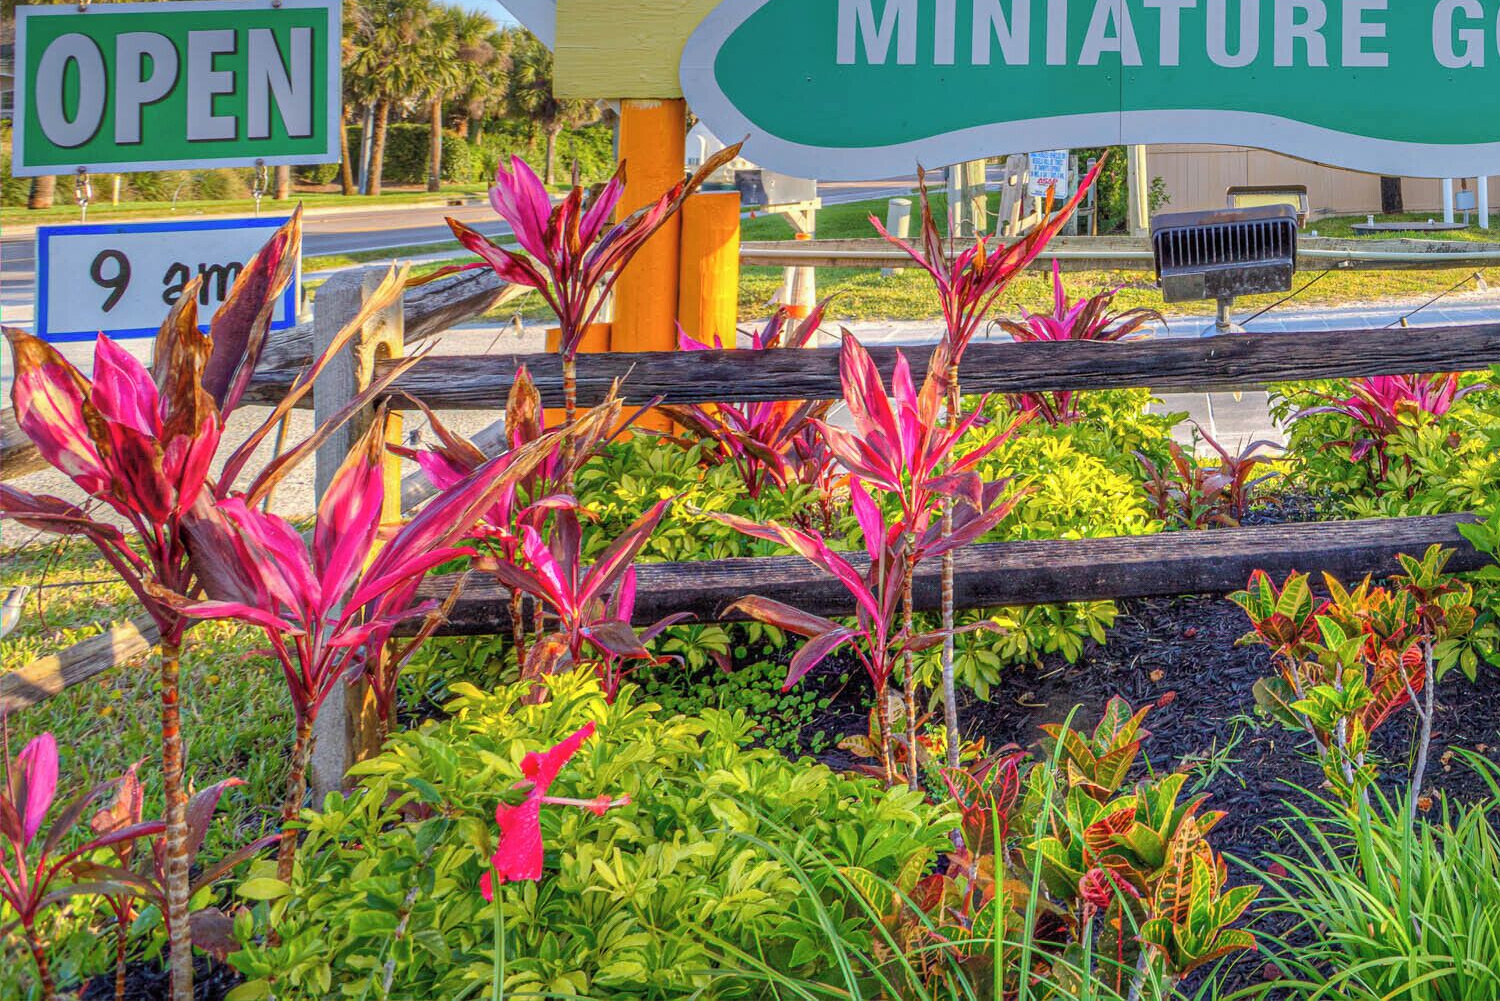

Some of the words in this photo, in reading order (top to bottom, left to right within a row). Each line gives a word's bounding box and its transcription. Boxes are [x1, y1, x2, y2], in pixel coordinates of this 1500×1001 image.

[35, 27, 314, 150] OPEN
[90, 249, 132, 313] 9
[162, 261, 245, 306] am
